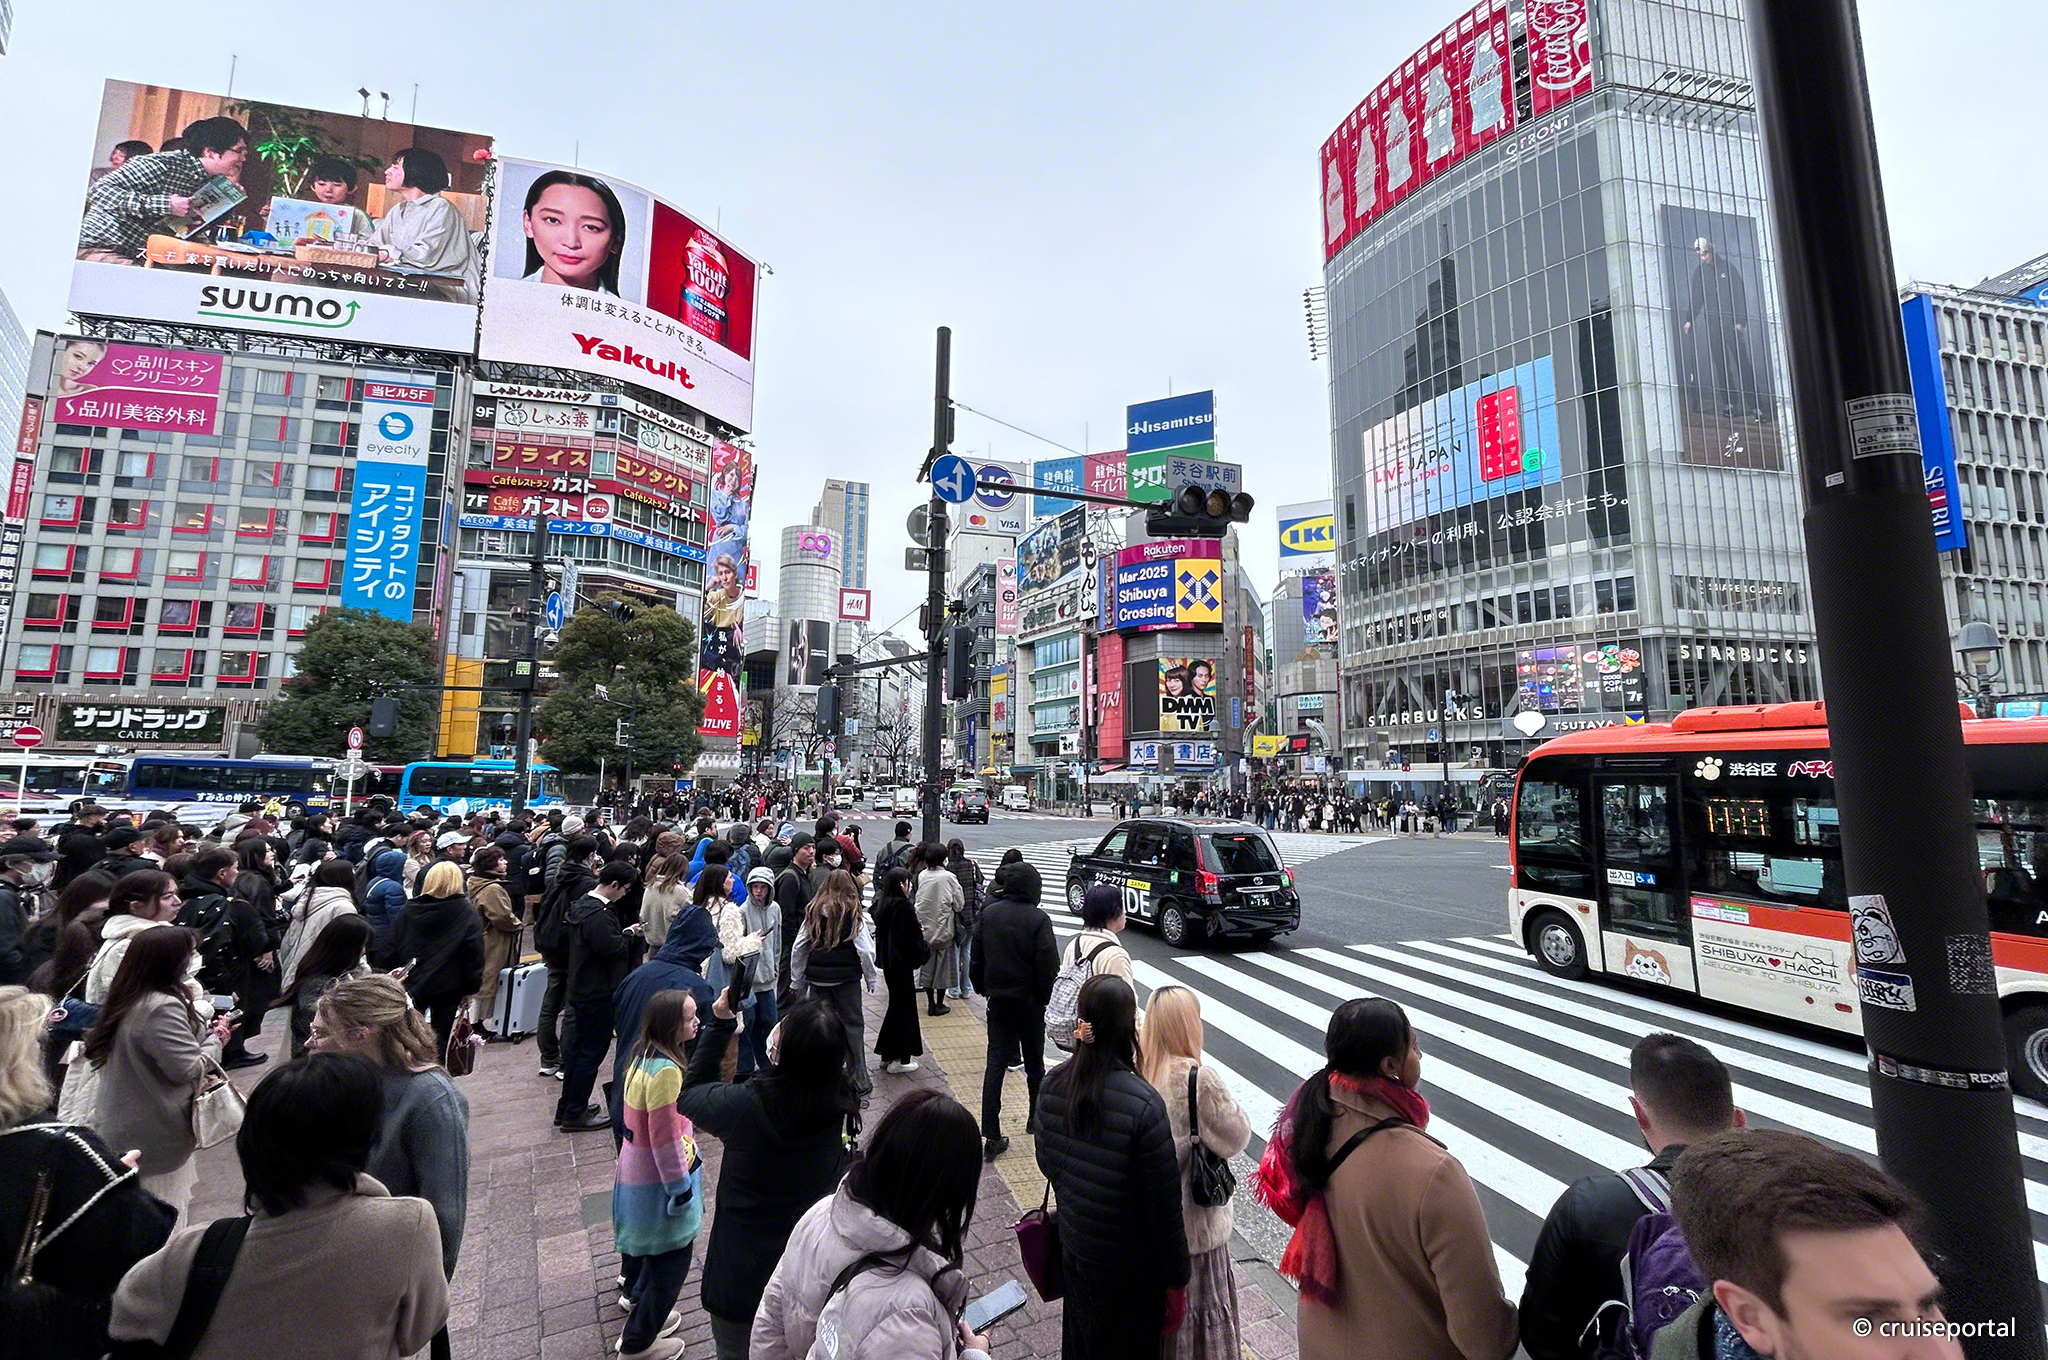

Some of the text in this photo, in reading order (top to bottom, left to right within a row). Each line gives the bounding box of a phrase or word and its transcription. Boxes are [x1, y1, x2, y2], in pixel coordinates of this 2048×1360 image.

[1506, 115, 1570, 155] QFRONT
[136, 247, 176, 262] スーモ
[687, 251, 727, 288] Yakult
[687, 265, 725, 298] 1000
[561, 292, 708, 355] 体調は変えることができる。
[134, 355, 215, 373] 品川スキン
[572, 332, 695, 390] Yakult
[133, 369, 204, 387] クリニック
[372, 385, 428, 400] 当ビル5F
[490, 383, 592, 402] しゃぶしゃぶバイキング
[79, 400, 207, 427] 品川美容外科
[475, 406, 495, 418] 9F
[532, 407, 589, 428] しゃぶ葉
[1128, 413, 1213, 436] Hisamitsu
[367, 443, 420, 458] eyecity
[496, 445, 588, 467] プライス
[1172, 460, 1237, 483] 渋谷駅前
[1375, 440, 1462, 484] LIVE JAPAN
[616, 456, 689, 494] コンタクト
[552, 477, 597, 494] ガスト
[466, 493, 489, 507] 7F
[494, 496, 519, 506] Café
[494, 505, 518, 513] レストラン
[521, 496, 578, 518] ガスト
[589, 506, 607, 514] ガスト
[669, 502, 700, 522] ガスト
[464, 516, 494, 526] AEON
[591, 524, 604, 534] 6F
[1000, 519, 1020, 530] VISA
[353, 482, 391, 598] アイシティ
[384, 485, 415, 600] コンタクトの
[616, 528, 706, 560] AEON 英会話イーオン
[797, 531, 832, 559] 109
[1143, 544, 1186, 557] Rakuten
[1081, 535, 1097, 615] もんじゃ
[1119, 565, 1168, 585] Mar.2025
[1119, 587, 1168, 604] Shibuya
[1119, 603, 1175, 622] Crossing
[1680, 644, 1807, 664] STARBUCKS
[715, 631, 728, 713] 私が、始まる。
[1603, 679, 1639, 687] POP-UP
[1626, 690, 1643, 702] 7F
[17, 705, 34, 714] 2F
[1162, 697, 1215, 715] DMM
[73, 706, 210, 730] サンドラッグ
[1177, 714, 1200, 730] TV
[1368, 706, 1484, 728] STARBUCKS
[1553, 719, 1615, 731] TSUTAYA
[118, 730, 159, 739] CARER
[1133, 743, 1211, 760] 大盛書店
[1729, 762, 1778, 777] 渋谷区
[1095, 872, 1127, 886] タクシーアプリ
[1609, 870, 1633, 880] 出入口
[1702, 944, 1837, 979] SHIBUYA HACHI
[1703, 960, 1755, 976] WELCOME
[1761, 971, 1777, 980] TO
[1783, 976, 1840, 994] SHIBUYA
